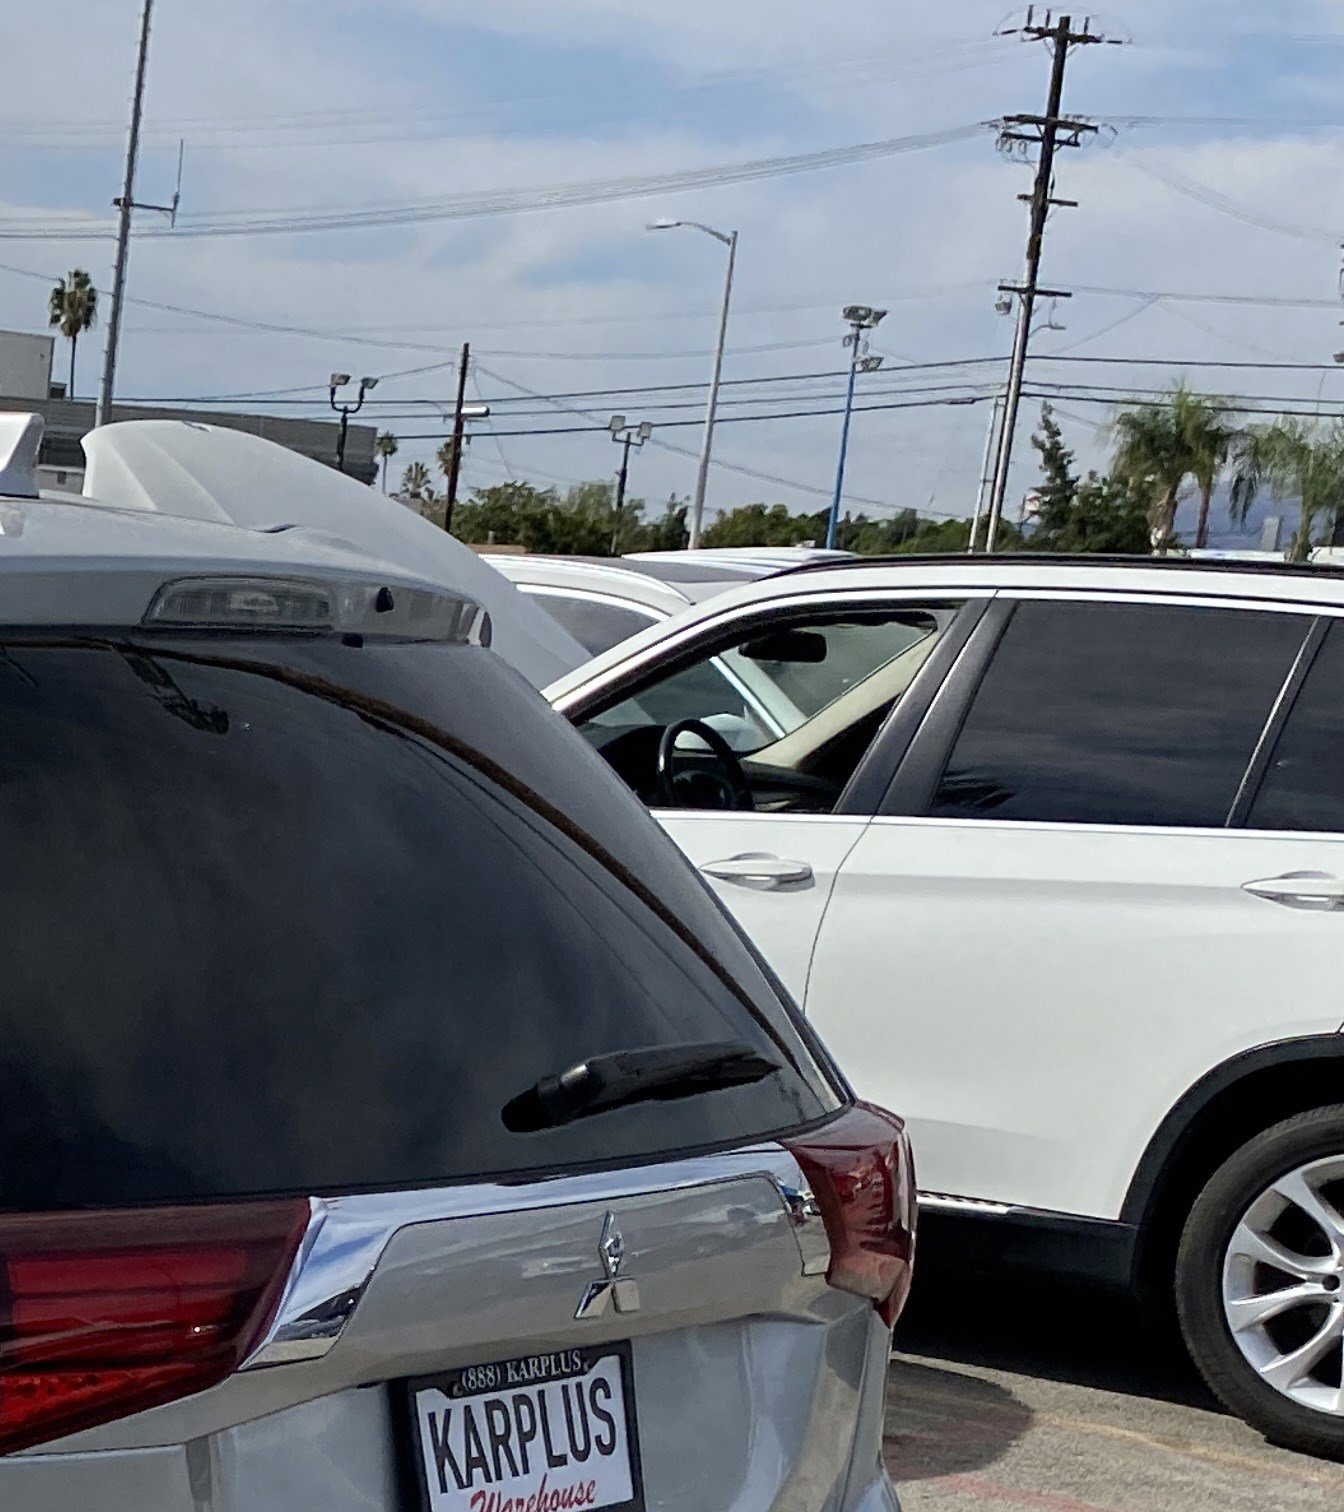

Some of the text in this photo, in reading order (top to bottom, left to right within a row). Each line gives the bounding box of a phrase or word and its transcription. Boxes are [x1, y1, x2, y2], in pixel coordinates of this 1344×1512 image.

[462, 1350, 582, 1391] (888) KARPLUS
[428, 1377, 616, 1494] KARPLUS
